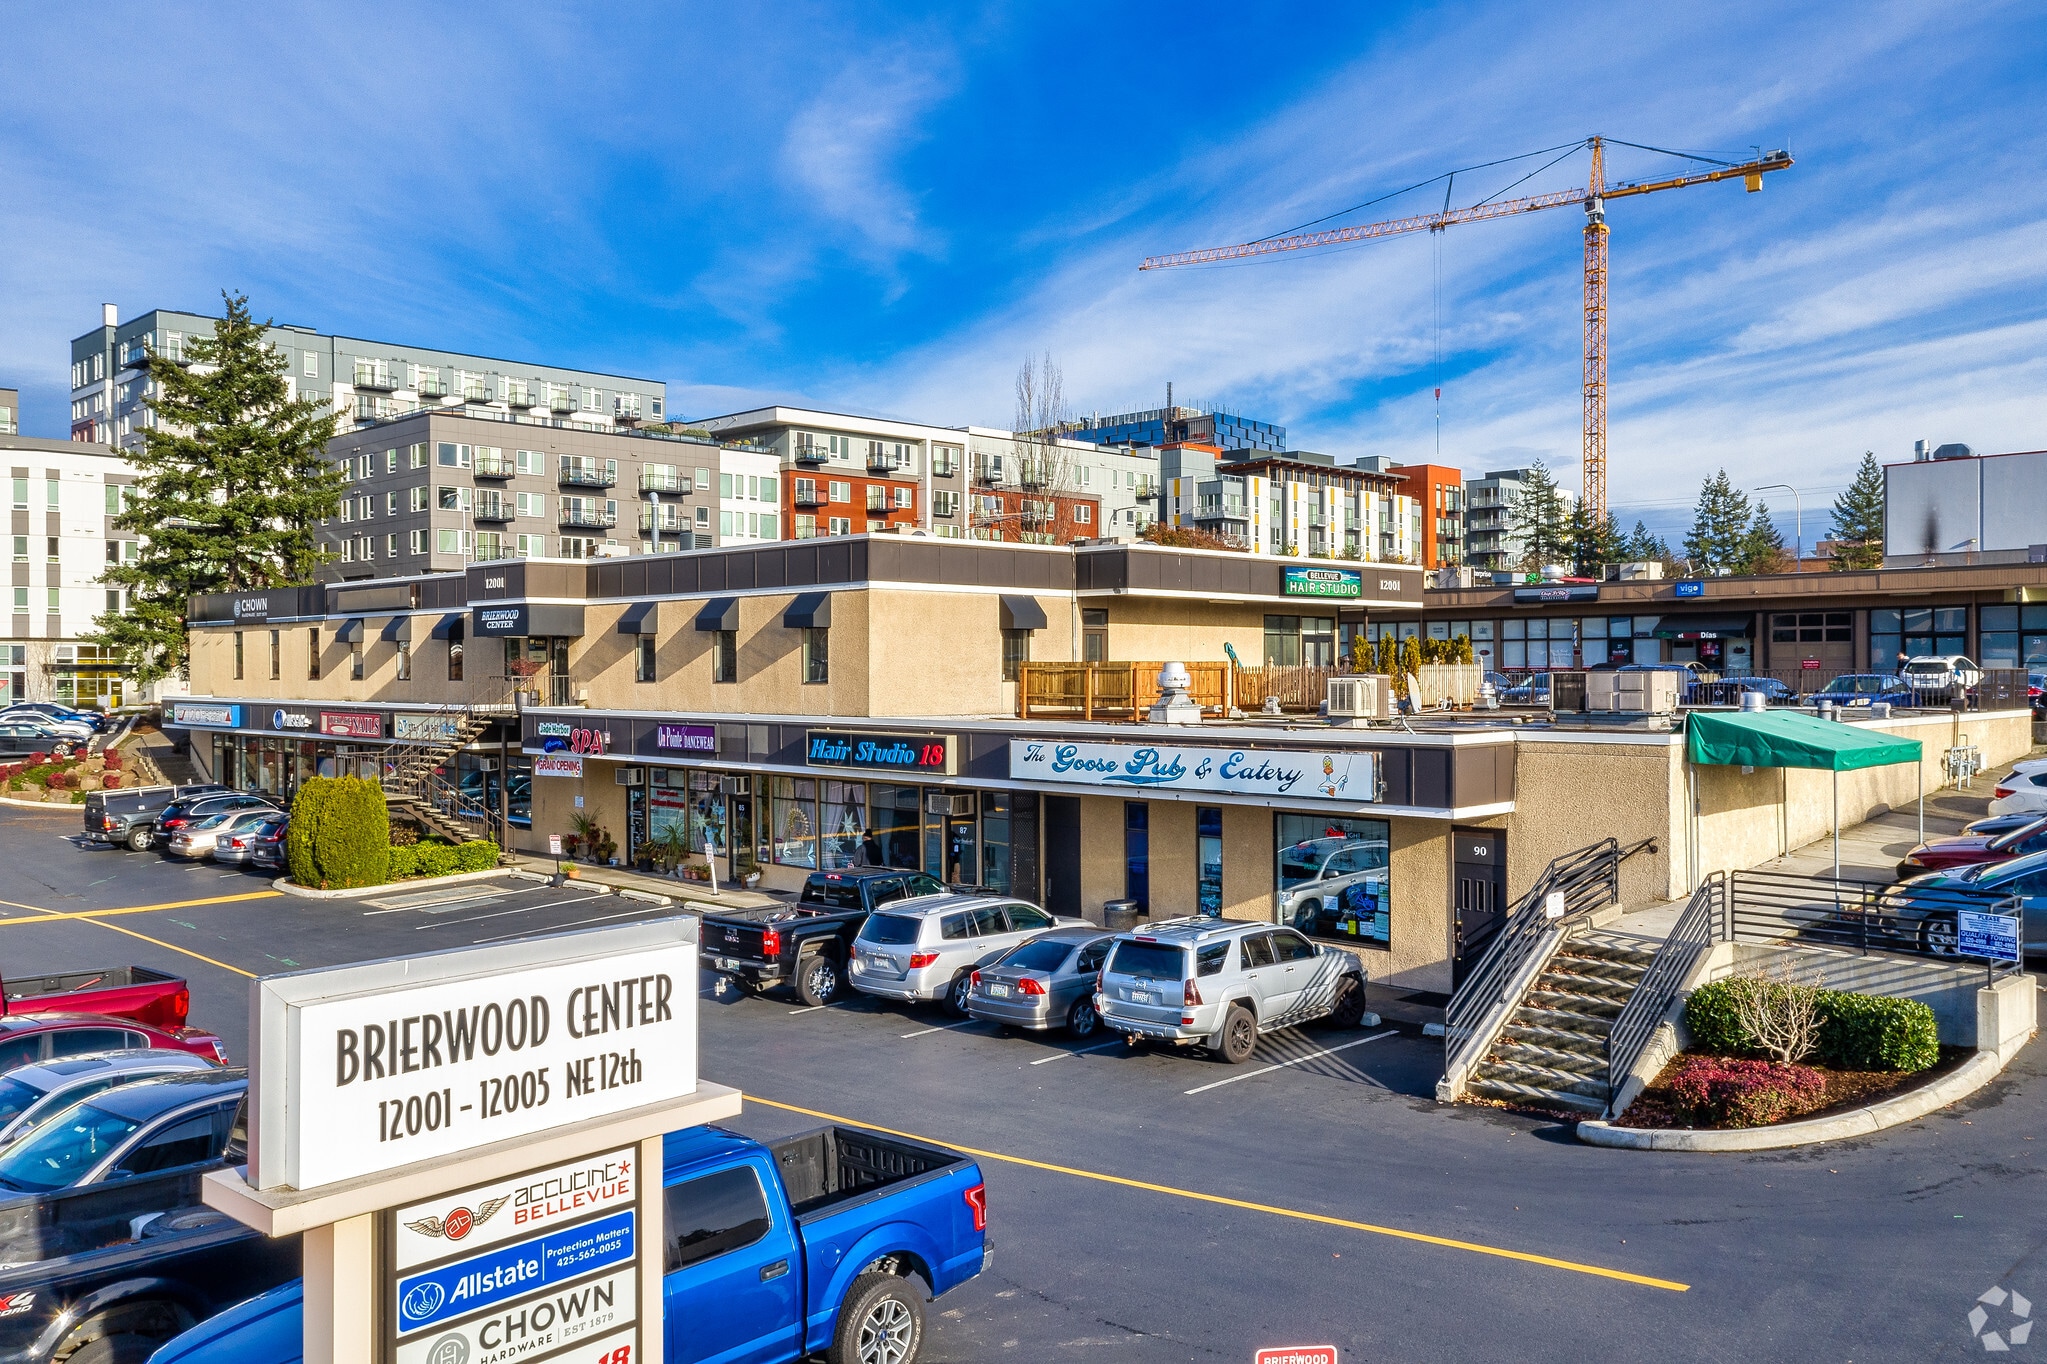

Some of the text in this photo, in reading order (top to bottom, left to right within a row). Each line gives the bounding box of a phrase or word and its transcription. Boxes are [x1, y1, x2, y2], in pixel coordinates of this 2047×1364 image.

[485, 577, 504, 589] 12001
[1310, 572, 1339, 581] BELLEVUE
[1380, 579, 1401, 591] 12001
[1290, 581, 1358, 595] HAIR STUDIO
[1680, 584, 1699, 593] vigo
[241, 597, 268, 612] CHOWN
[481, 609, 519, 621] BRIERWOOD
[486, 620, 514, 629] CENTER
[1700, 631, 1717, 639] Días
[352, 716, 380, 735] NAILS
[539, 723, 570, 735] Jade Harbor
[571, 728, 604, 756] SPA
[658, 726, 714, 750] On Pointe DANCEWEAR
[809, 739, 944, 766] Hair Studio 18
[539, 759, 580, 771] GRAND OPENING
[1023, 744, 1304, 793] The Goose Pub & Eatery
[959, 826, 968, 834] 87
[1473, 846, 1487, 856] 90
[1960, 930, 2016, 944] QUALITY TOWING
[336, 973, 672, 1087] BRIERWOOD CENTER
[378, 1088, 451, 1142] 12001
[480, 1067, 550, 1119] 12005
[566, 1056, 595, 1099] NE
[599, 1048, 642, 1090] 12th
[514, 1162, 618, 1207] accutint
[514, 1179, 630, 1225] BELLEVUE
[546, 1226, 630, 1259] Protection Matters
[556, 1240, 622, 1268] 425-562-0055
[449, 1258, 539, 1304] Allstate
[479, 1280, 614, 1350] CHOWN
[564, 1312, 614, 1337] EST 1879
[480, 1333, 554, 1364] HARDWARE
[1264, 1354, 1328, 1364] BRIERWOOD
